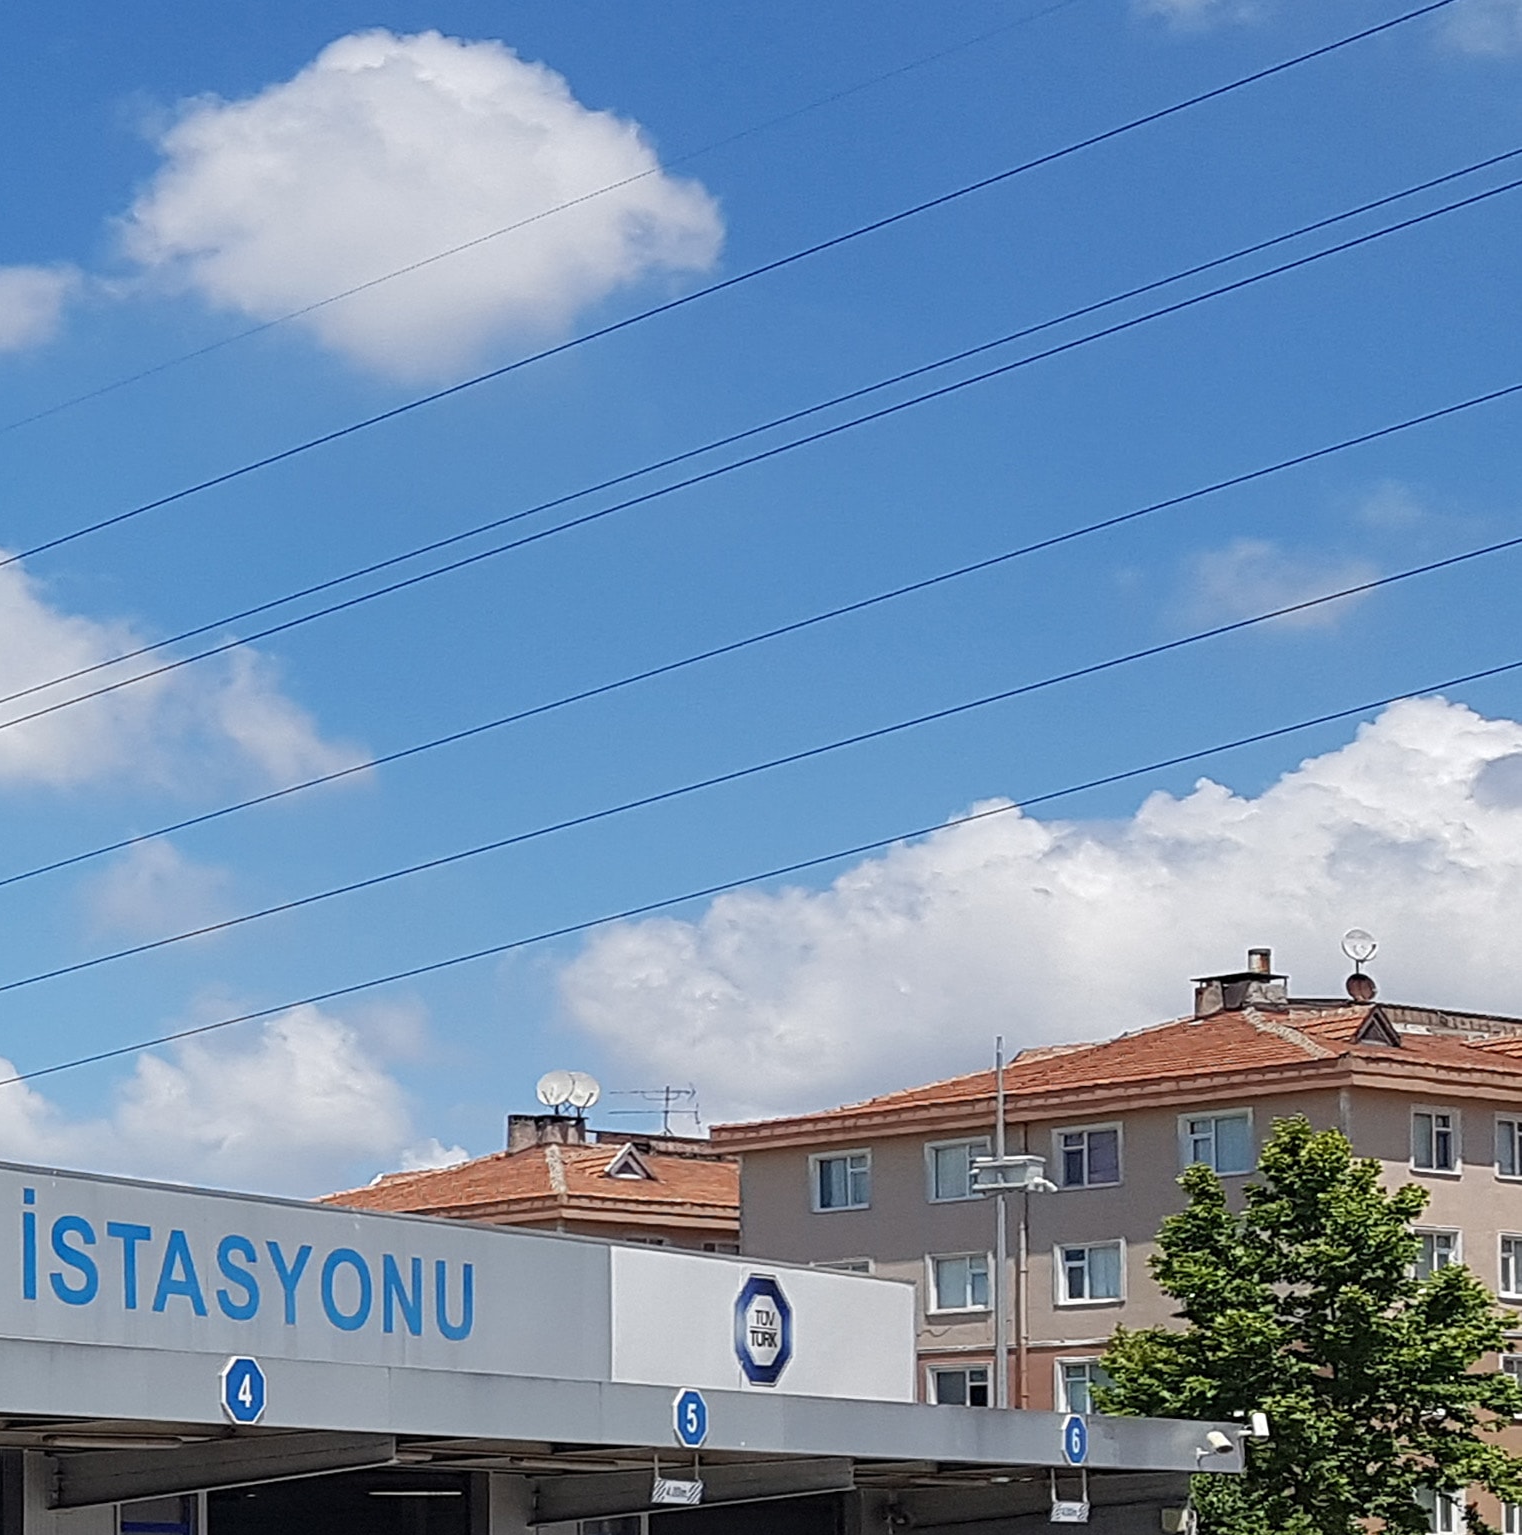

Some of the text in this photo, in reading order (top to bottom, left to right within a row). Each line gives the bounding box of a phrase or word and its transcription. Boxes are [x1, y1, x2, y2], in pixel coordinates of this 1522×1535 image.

[23, 1187, 474, 1342] İSTASYONU
[237, 1373, 253, 1408] 4
[686, 1402, 699, 1434] 5
[1071, 1427, 1081, 1454] 6
